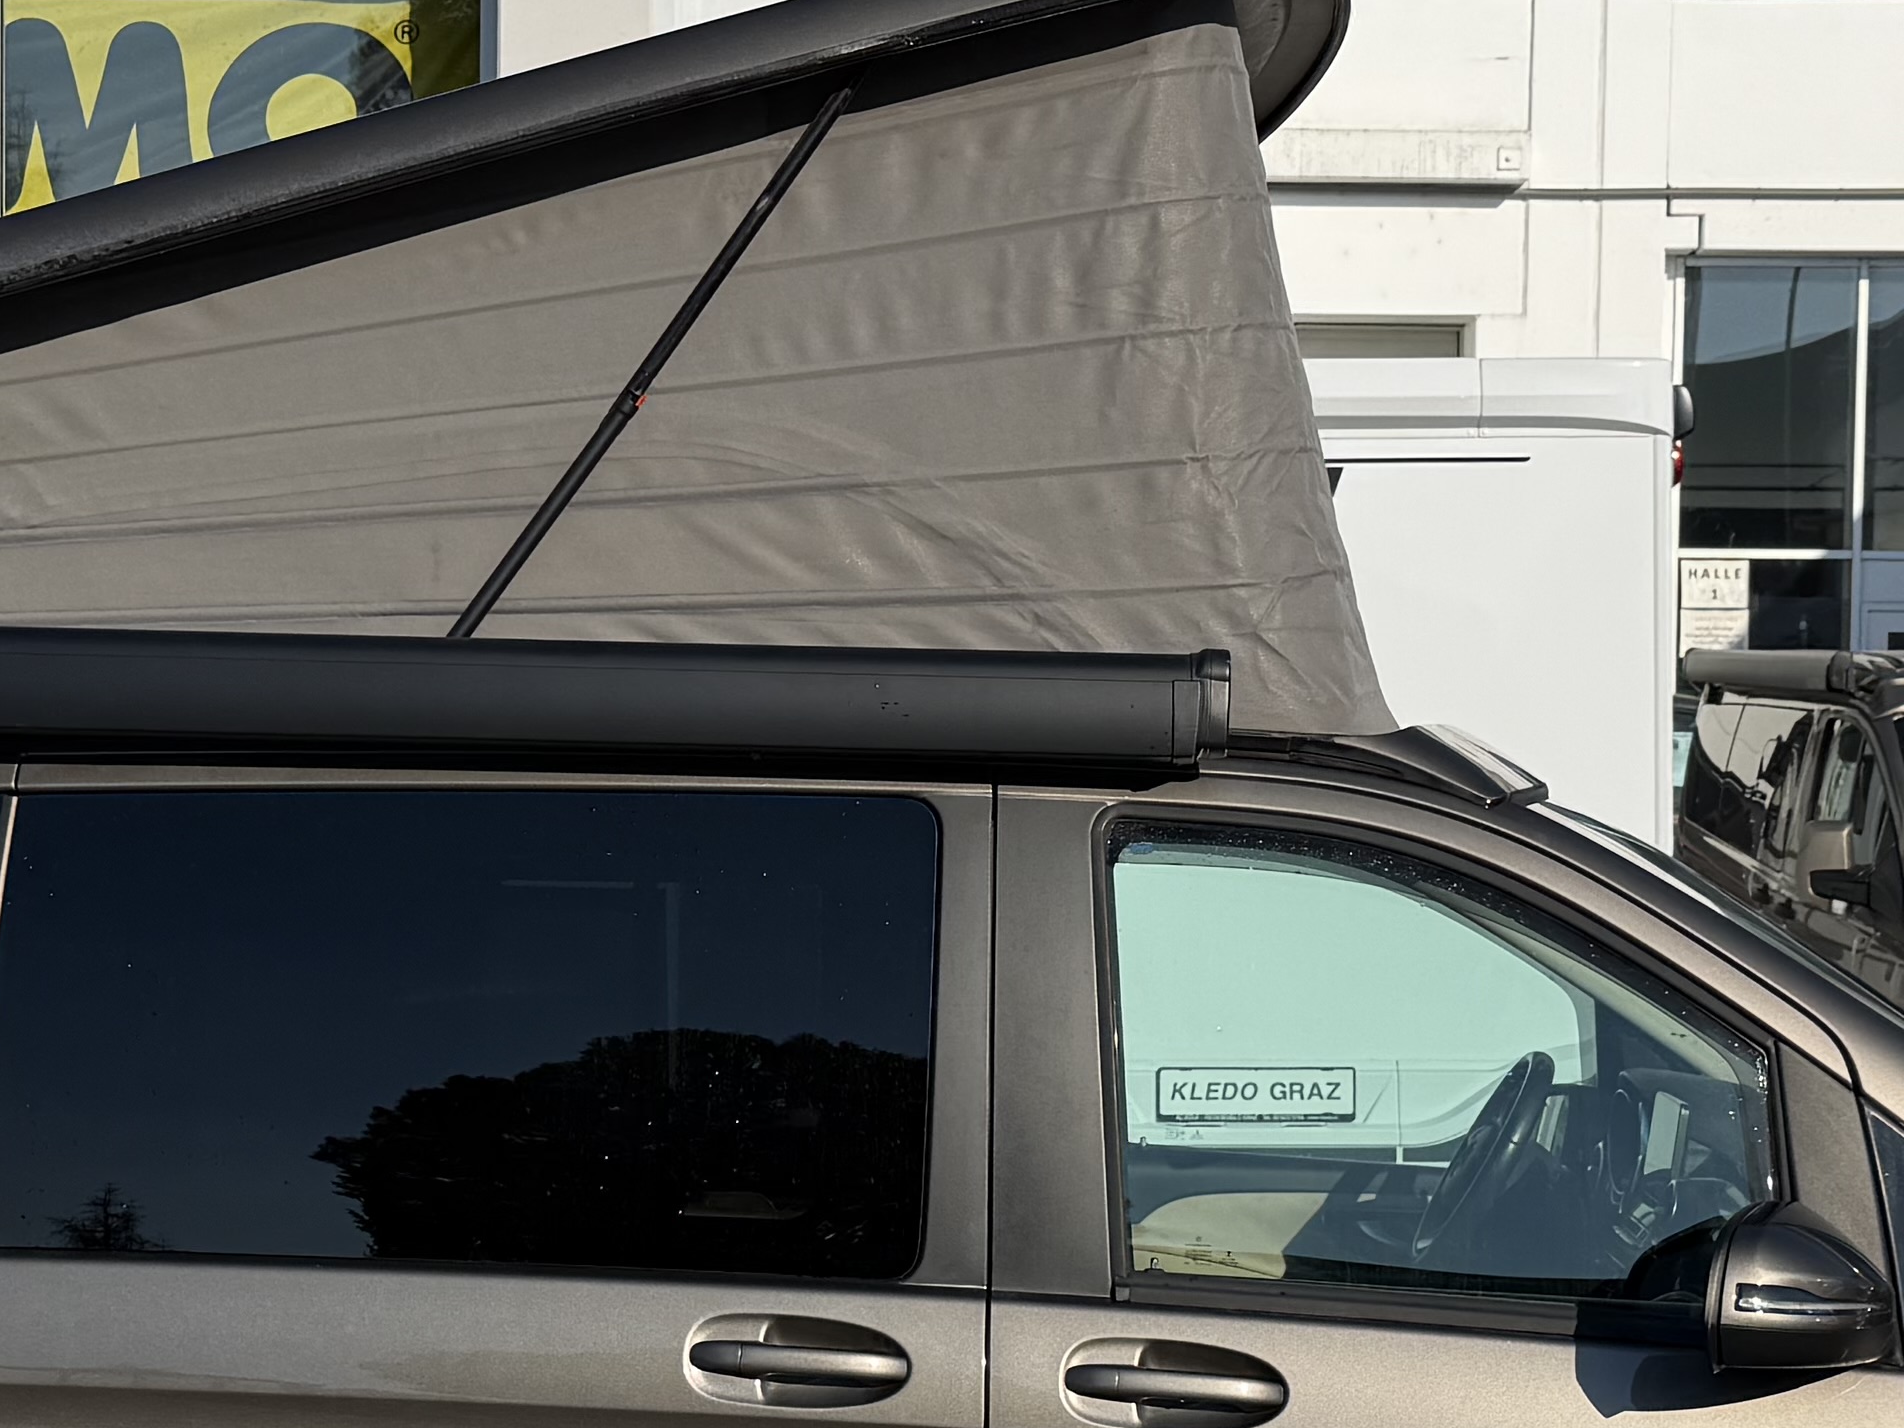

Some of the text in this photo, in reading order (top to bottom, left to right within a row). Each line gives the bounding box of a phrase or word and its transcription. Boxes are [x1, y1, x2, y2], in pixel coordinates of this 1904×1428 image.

[1688, 567, 1742, 580] HALLE
[1711, 588, 1718, 600] 1
[1171, 1082, 1342, 1101] KLEDO GRAZ
